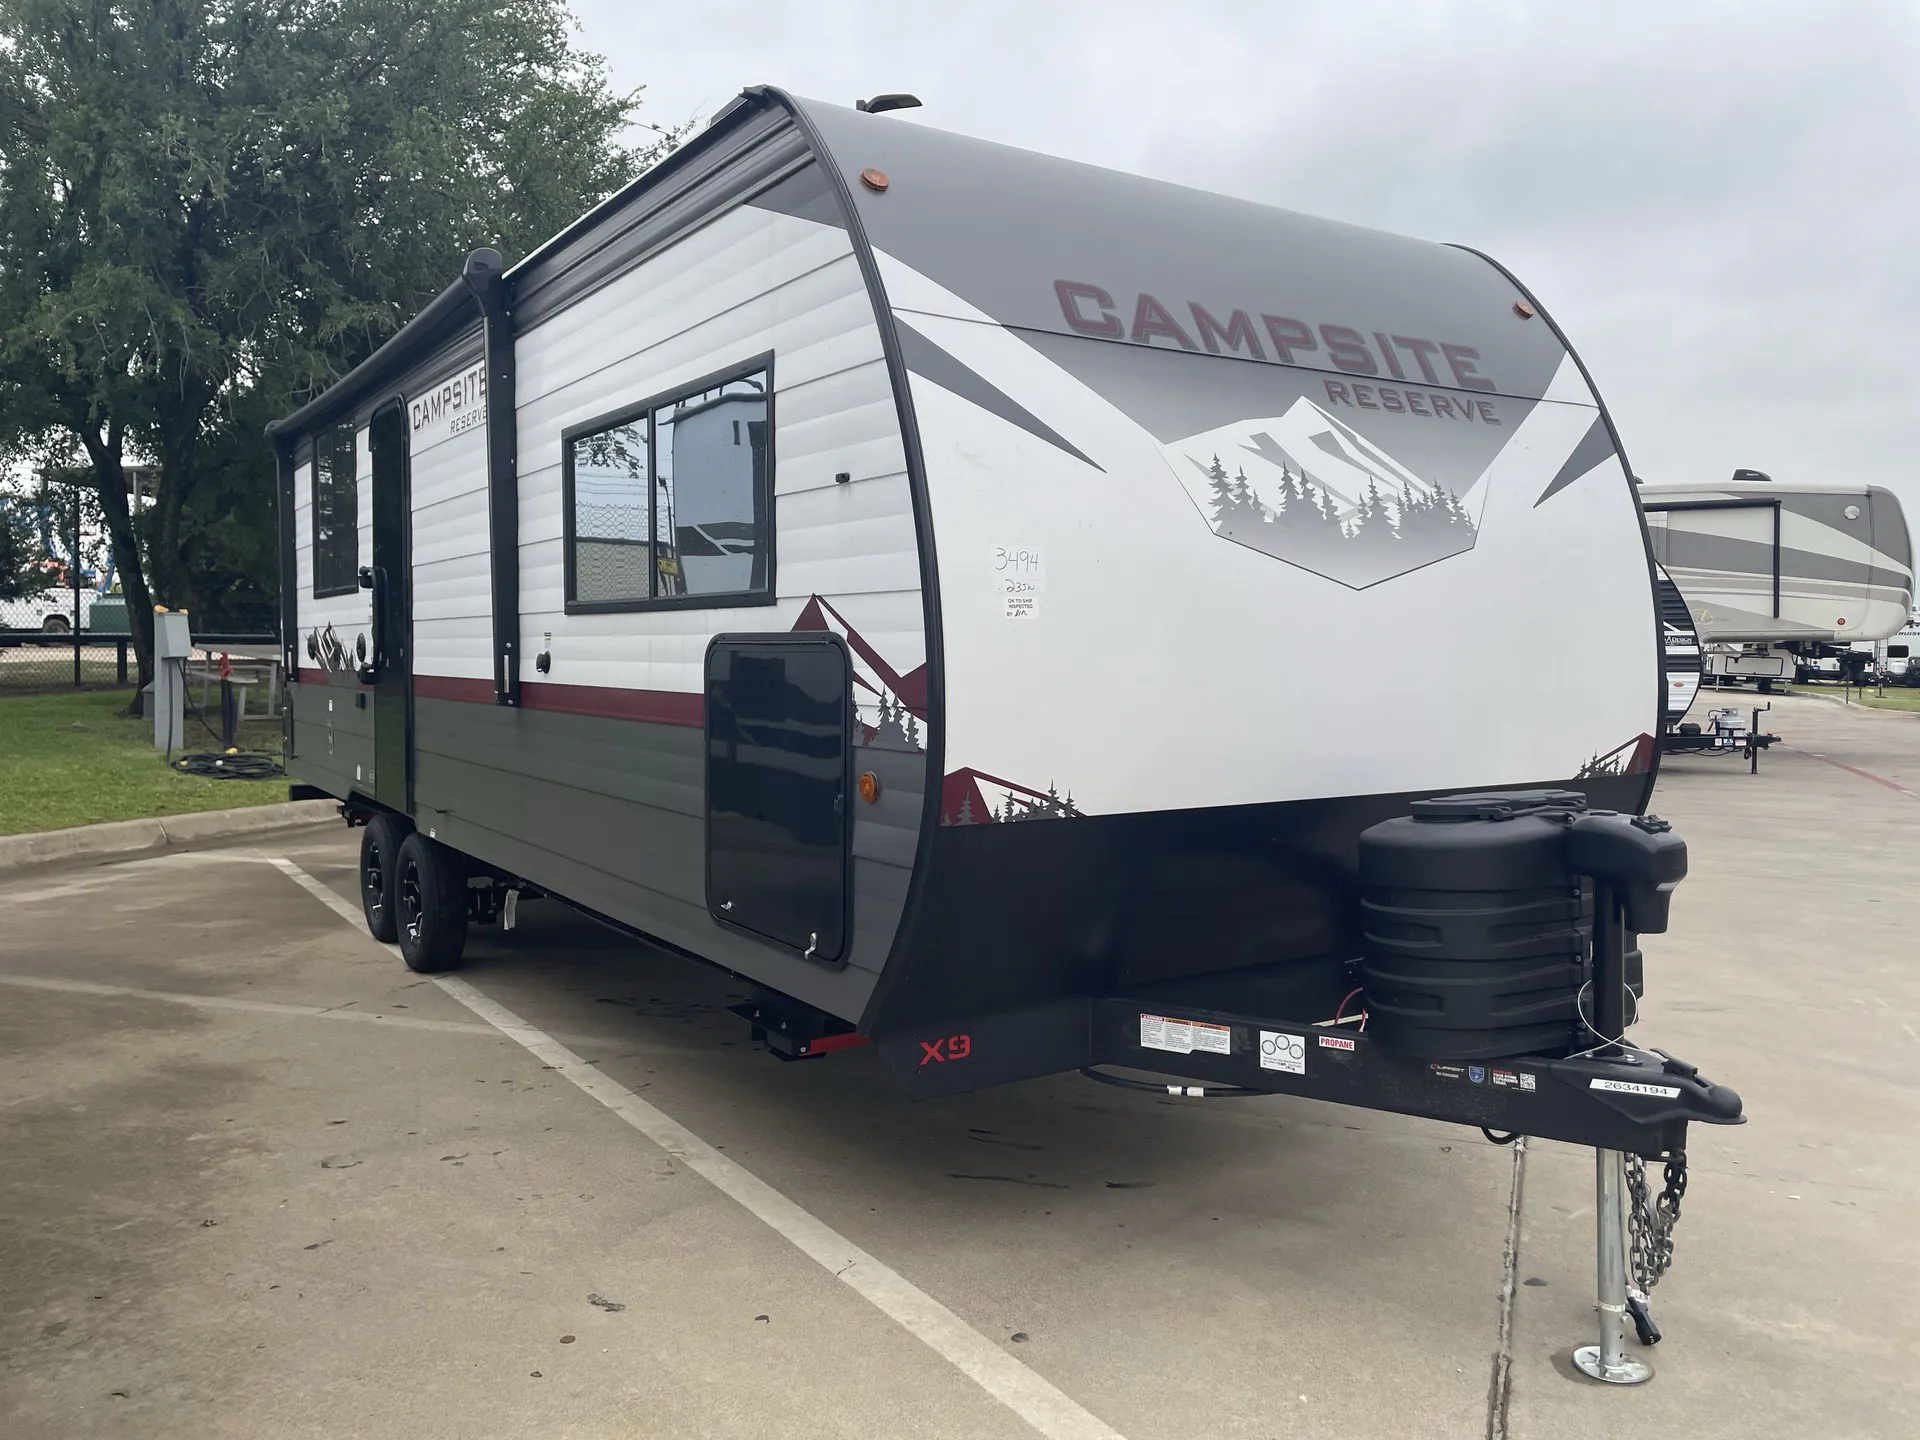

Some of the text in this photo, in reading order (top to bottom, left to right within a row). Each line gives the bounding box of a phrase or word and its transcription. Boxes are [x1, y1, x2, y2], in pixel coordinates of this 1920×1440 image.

[1053, 278, 1498, 392] CAMPSITE
[413, 366, 487, 433] CAMPSITE
[1323, 379, 1503, 426] RESERVE
[450, 404, 487, 434] RESERVE
[995, 547, 1039, 573] 3494
[920, 1034, 971, 1066] X9
[1320, 1037, 1353, 1050] PROPANE
[1603, 1081, 1668, 1096] 2634194
